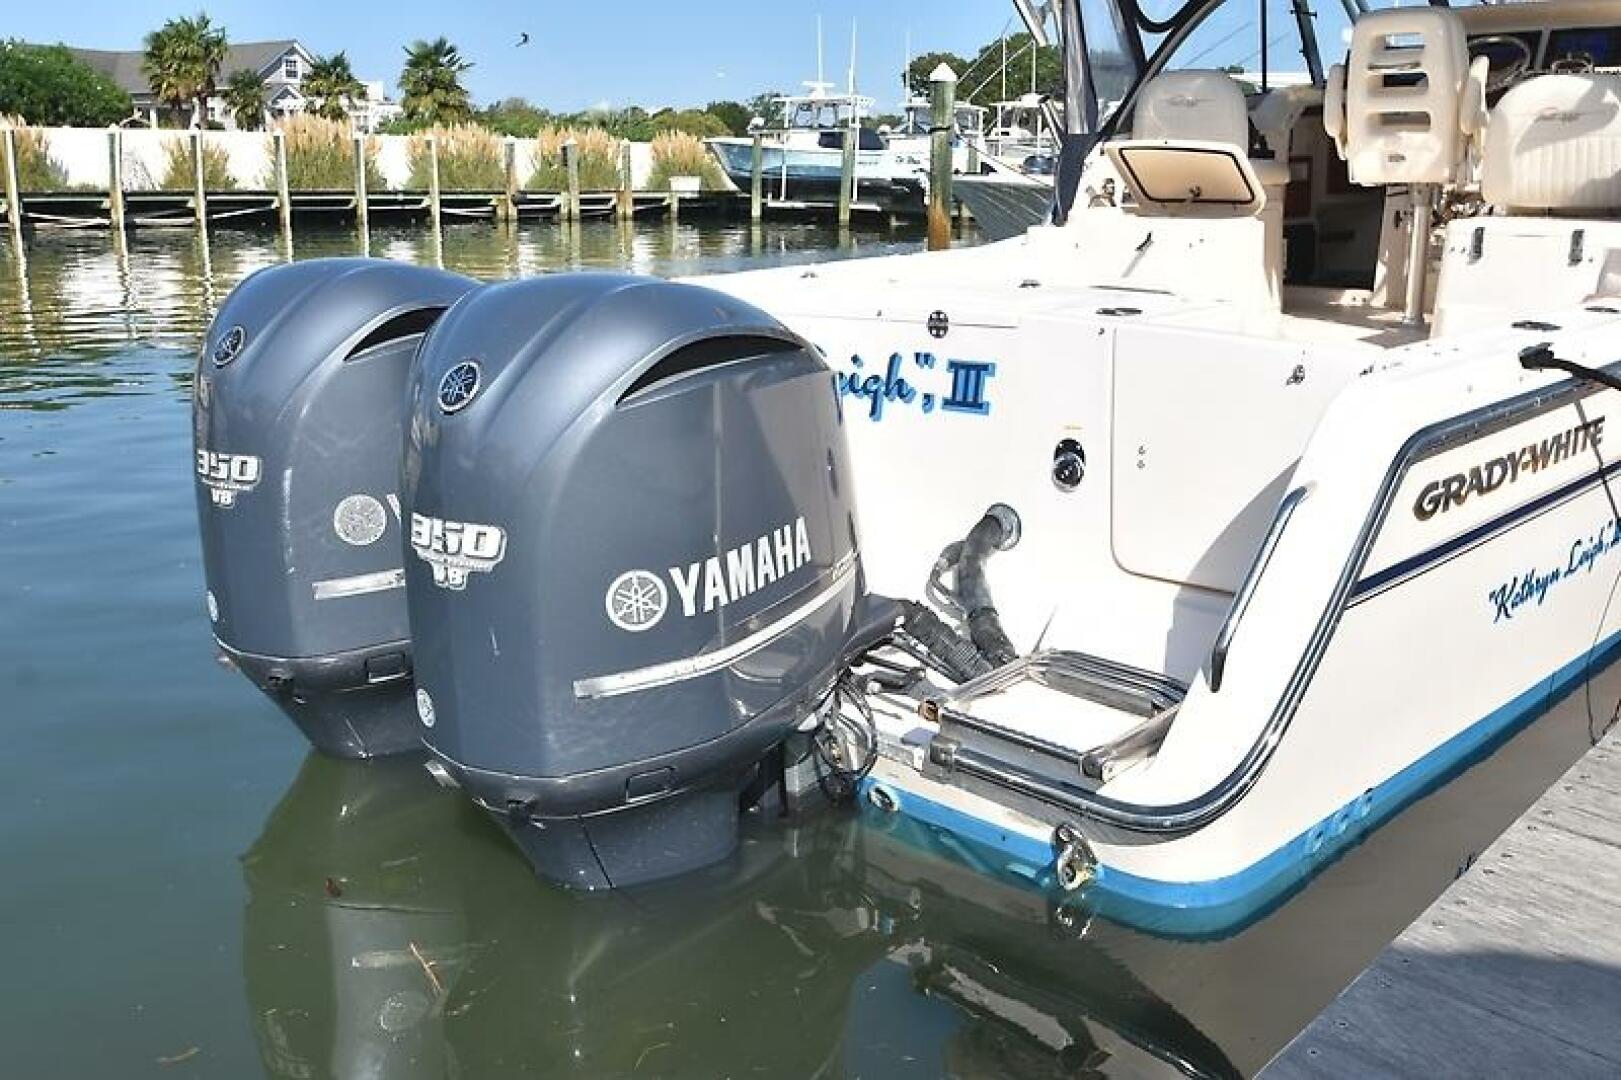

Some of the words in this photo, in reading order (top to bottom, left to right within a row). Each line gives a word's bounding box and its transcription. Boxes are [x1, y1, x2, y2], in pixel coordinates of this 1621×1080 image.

[942, 358, 996, 416] III
[198, 449, 260, 481] 350
[1413, 415, 1605, 521] GRADY-WHITE
[411, 512, 504, 560] 350
[668, 516, 812, 617] YAMAHA
